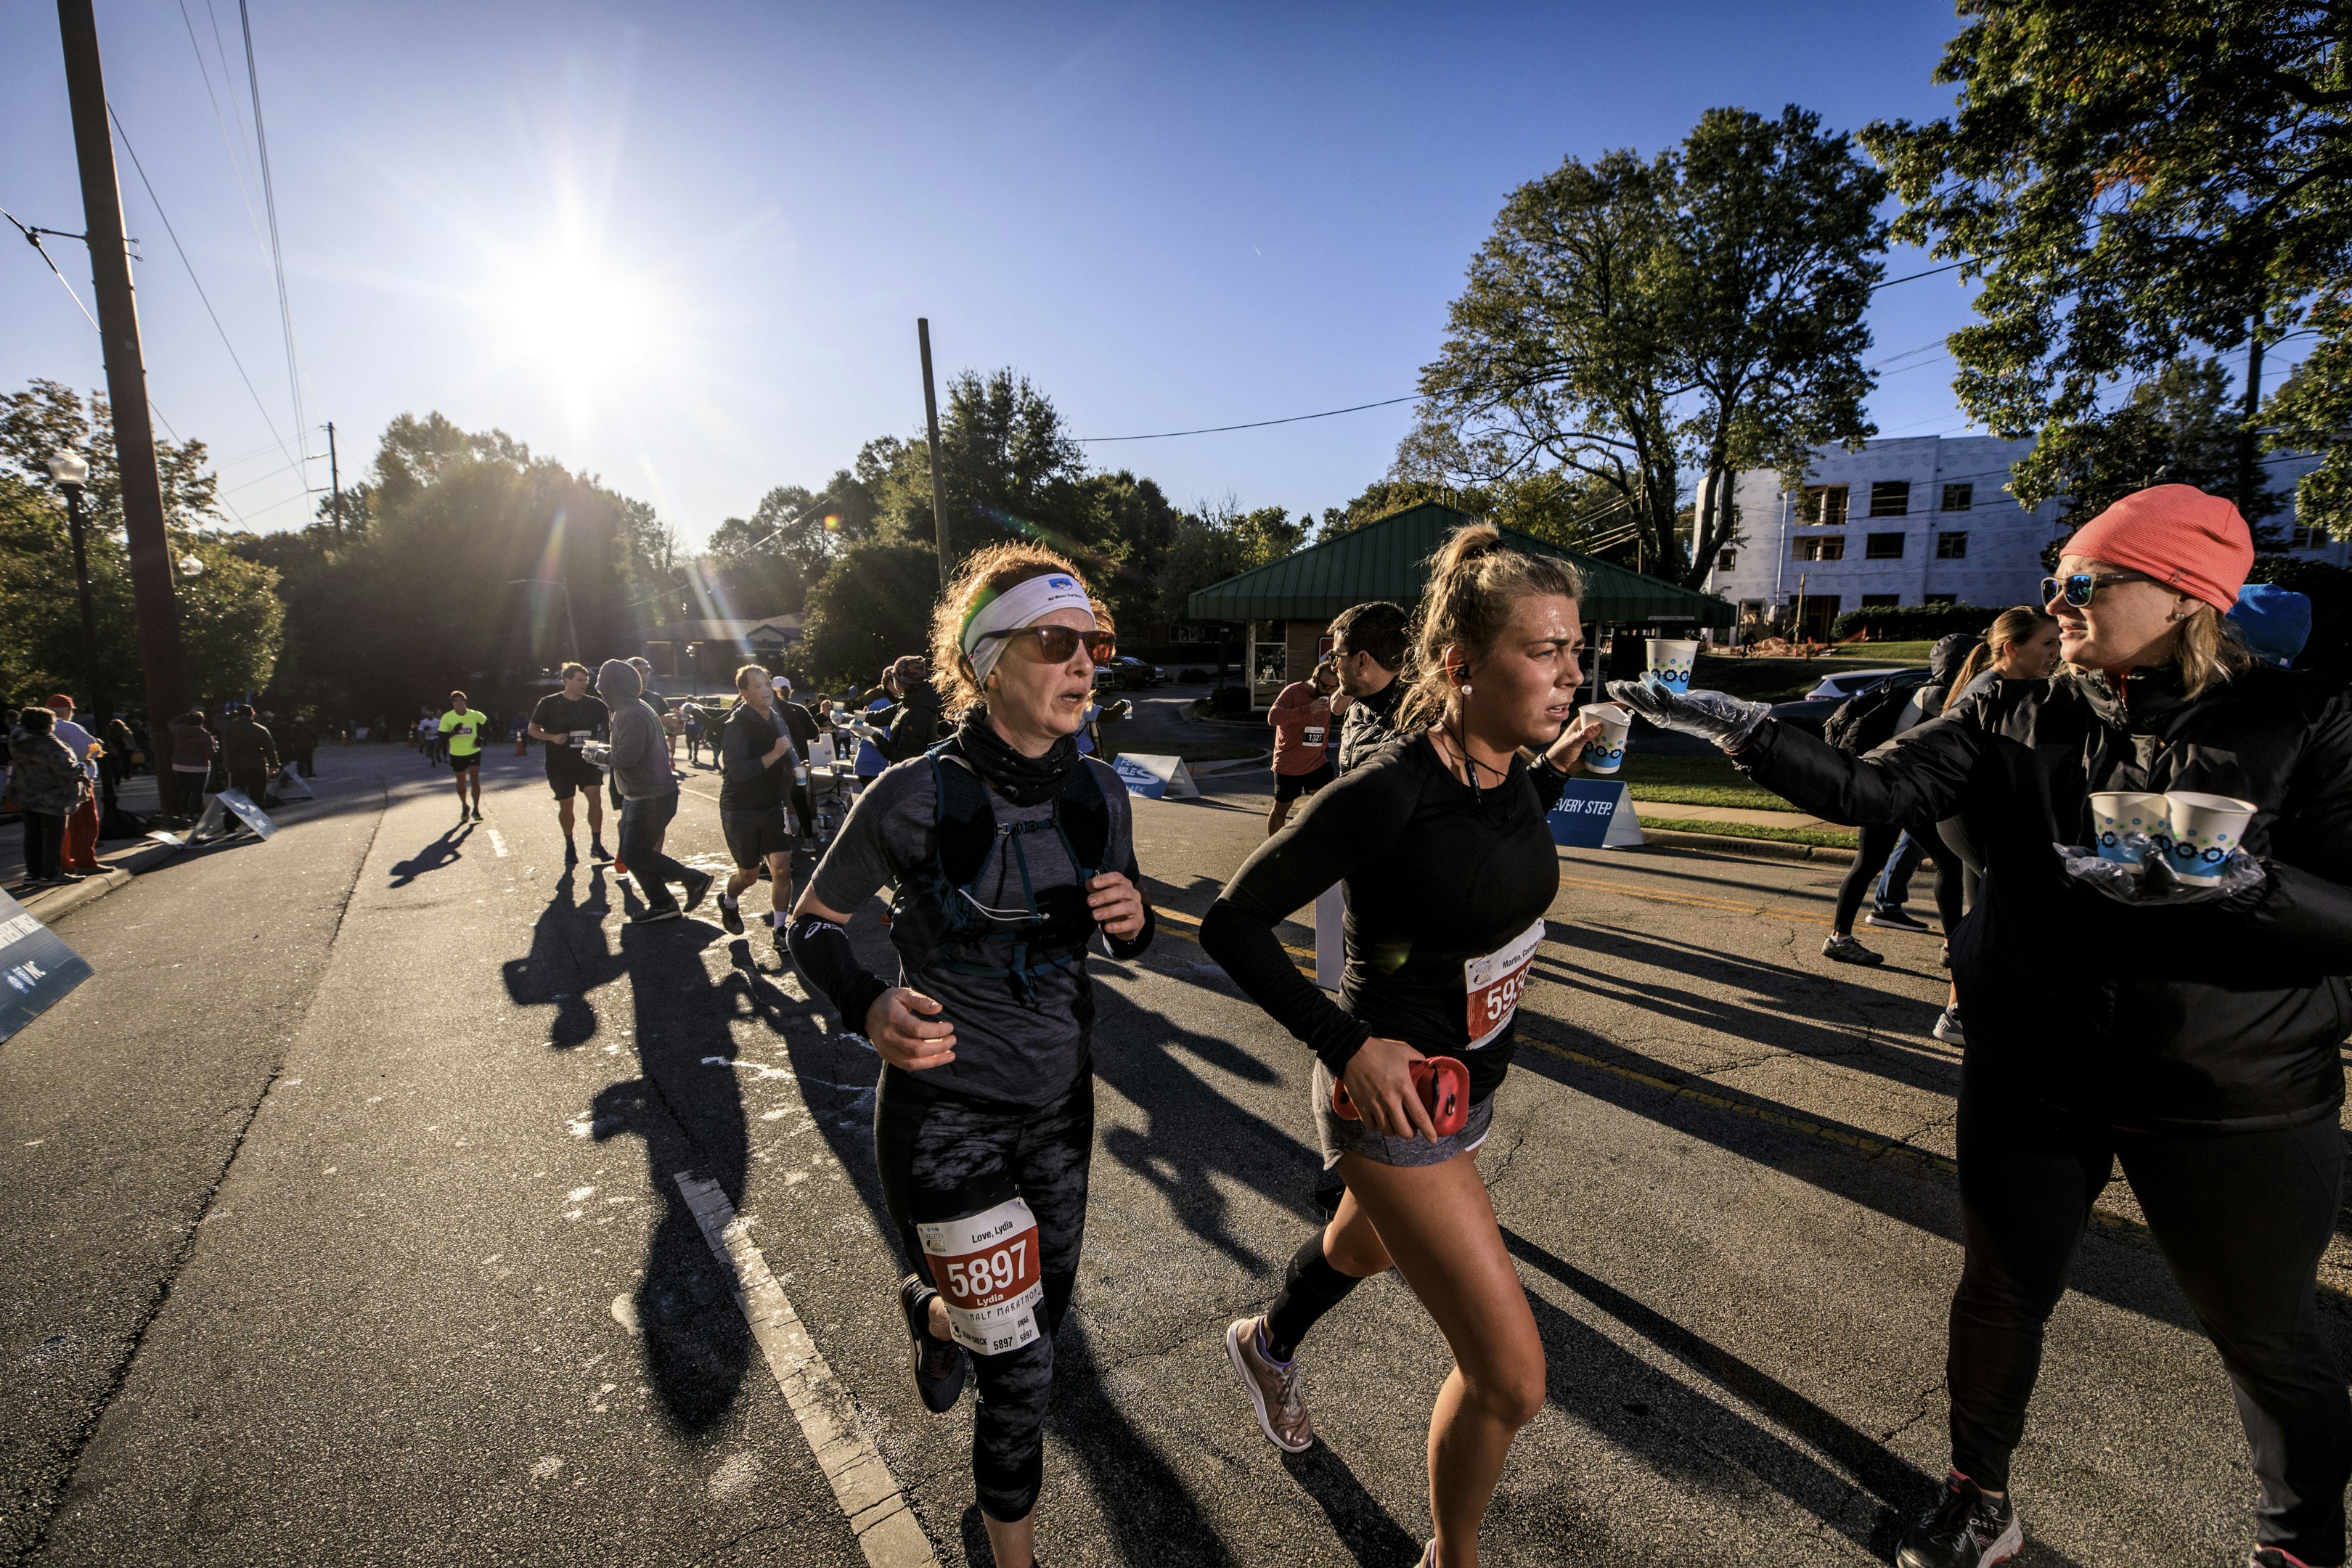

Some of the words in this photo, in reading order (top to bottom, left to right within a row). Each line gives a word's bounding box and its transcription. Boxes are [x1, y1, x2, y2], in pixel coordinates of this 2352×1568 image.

[1585, 801, 1613, 815] STEP.
[23, 960, 46, 980] NC
[971, 1231, 994, 1244] Love,
[995, 1221, 1013, 1235] Lydia
[947, 1239, 1026, 1297] 5897
[969, 1310, 992, 1320] HALF
[997, 1288, 1037, 1316] MARATHON
[976, 1294, 1004, 1307] Lydia
[1017, 1316, 1029, 1328] SWAG
[972, 1336, 987, 1346] CHECK
[993, 1336, 1013, 1350] 5897
[1020, 1330, 1032, 1342] 5897
